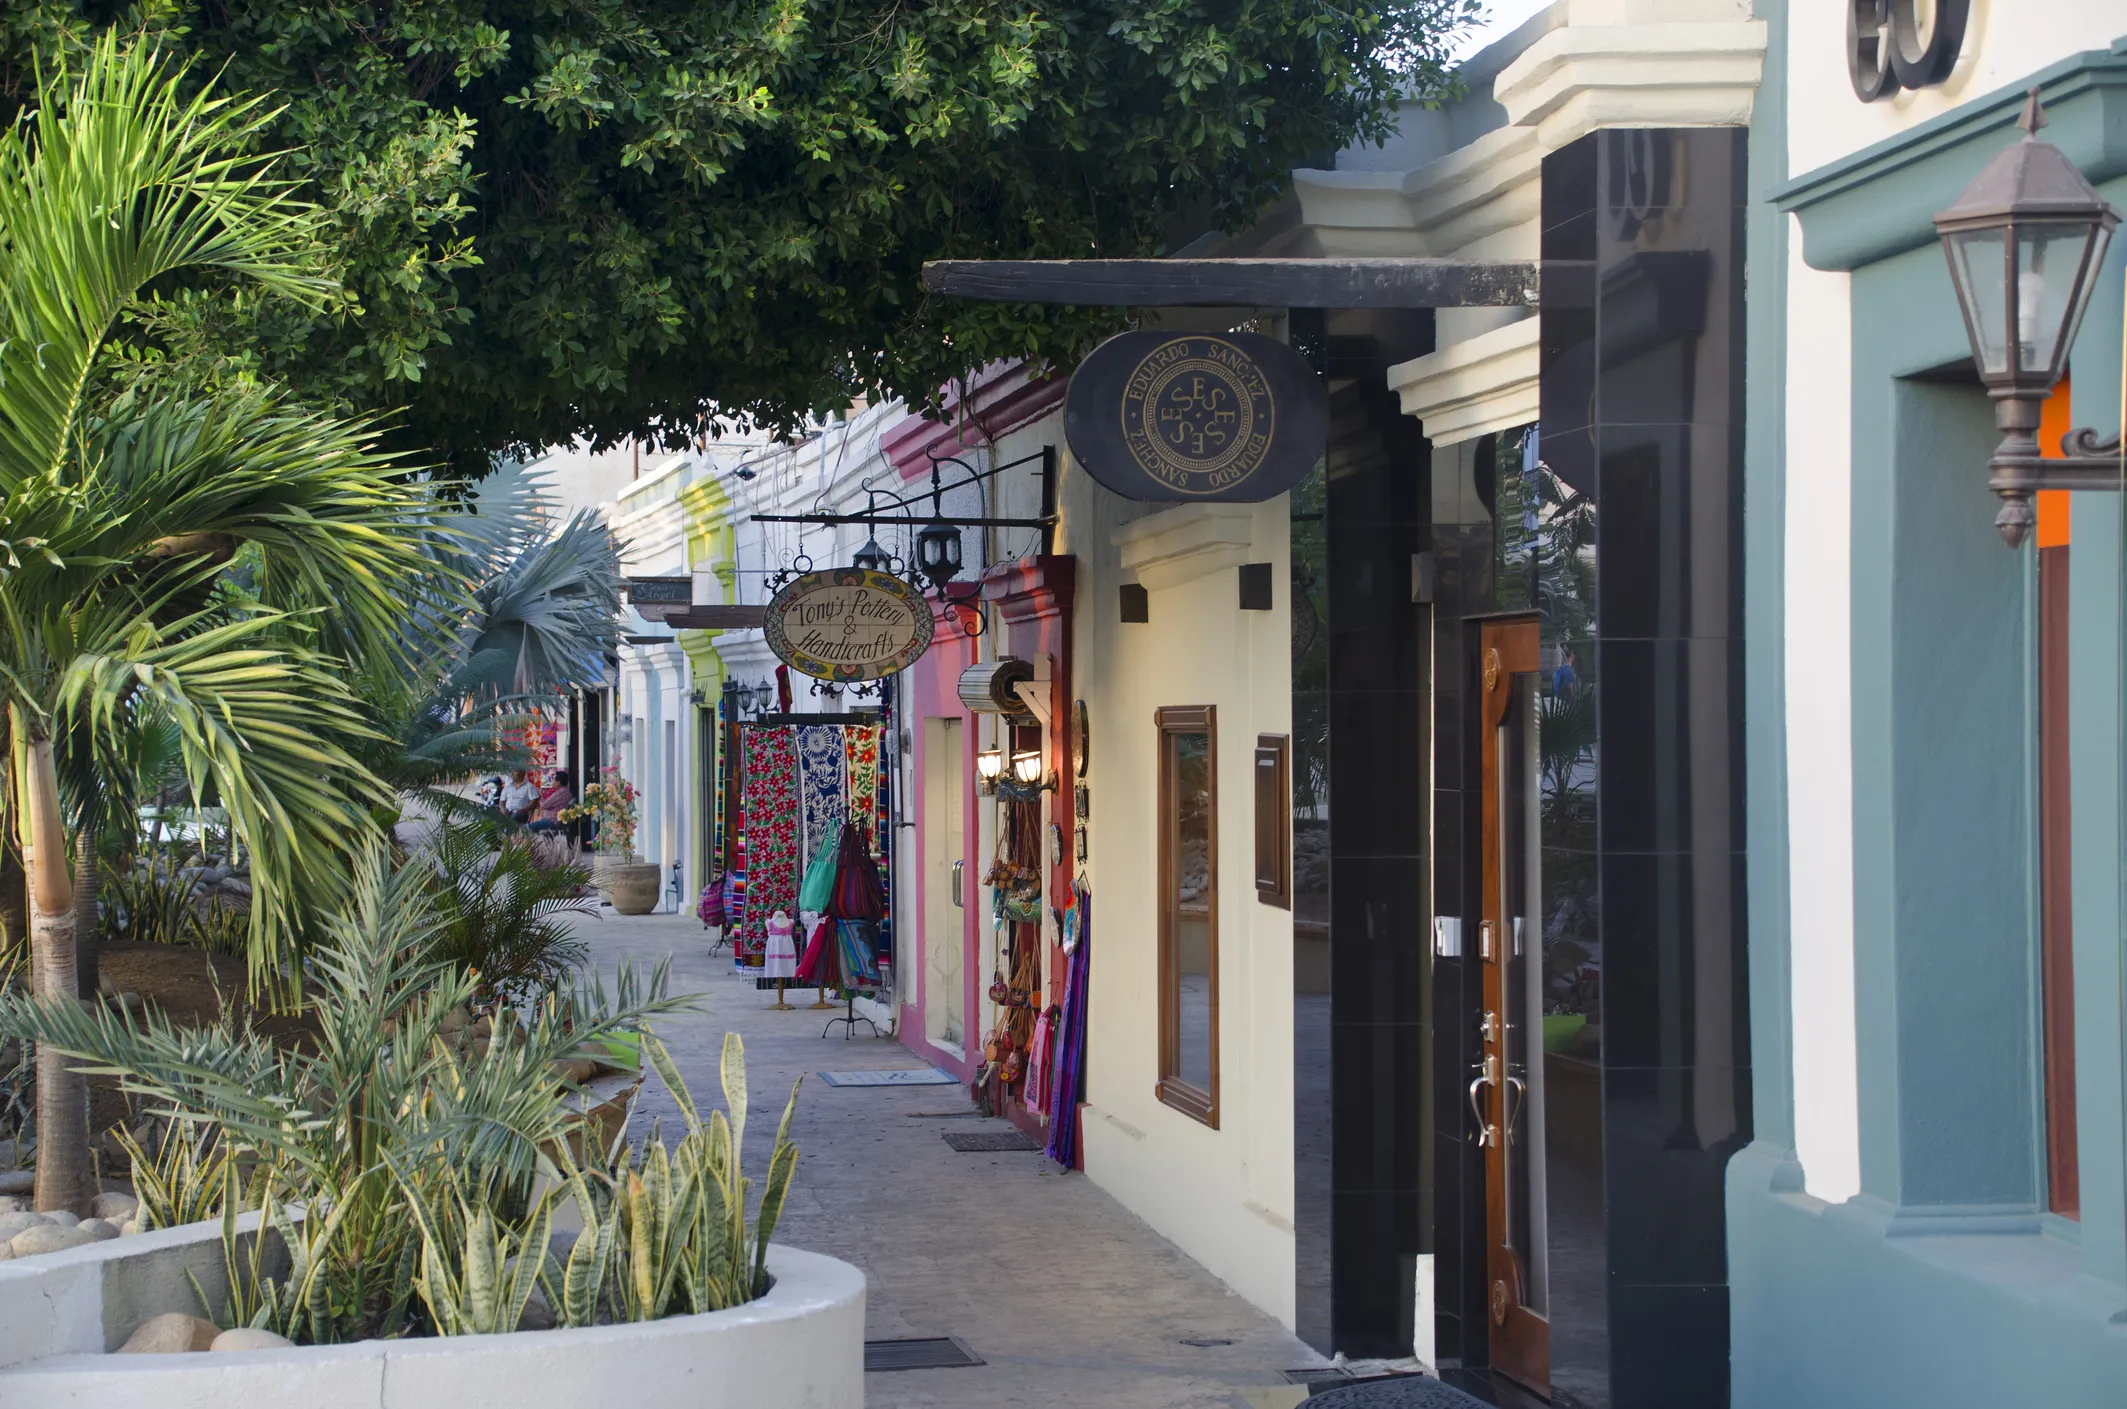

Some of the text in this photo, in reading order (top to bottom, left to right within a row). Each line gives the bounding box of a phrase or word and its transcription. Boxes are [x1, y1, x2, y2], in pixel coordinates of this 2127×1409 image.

[1128, 343, 1188, 402] EDUARDO
[1130, 428, 1189, 487] SANCHEZ
[1209, 432, 1267, 488] EDUARDO
[792, 589, 905, 627] Tony's Pottery
[843, 615, 858, 635] &
[797, 629, 894, 661] Handicrafts
